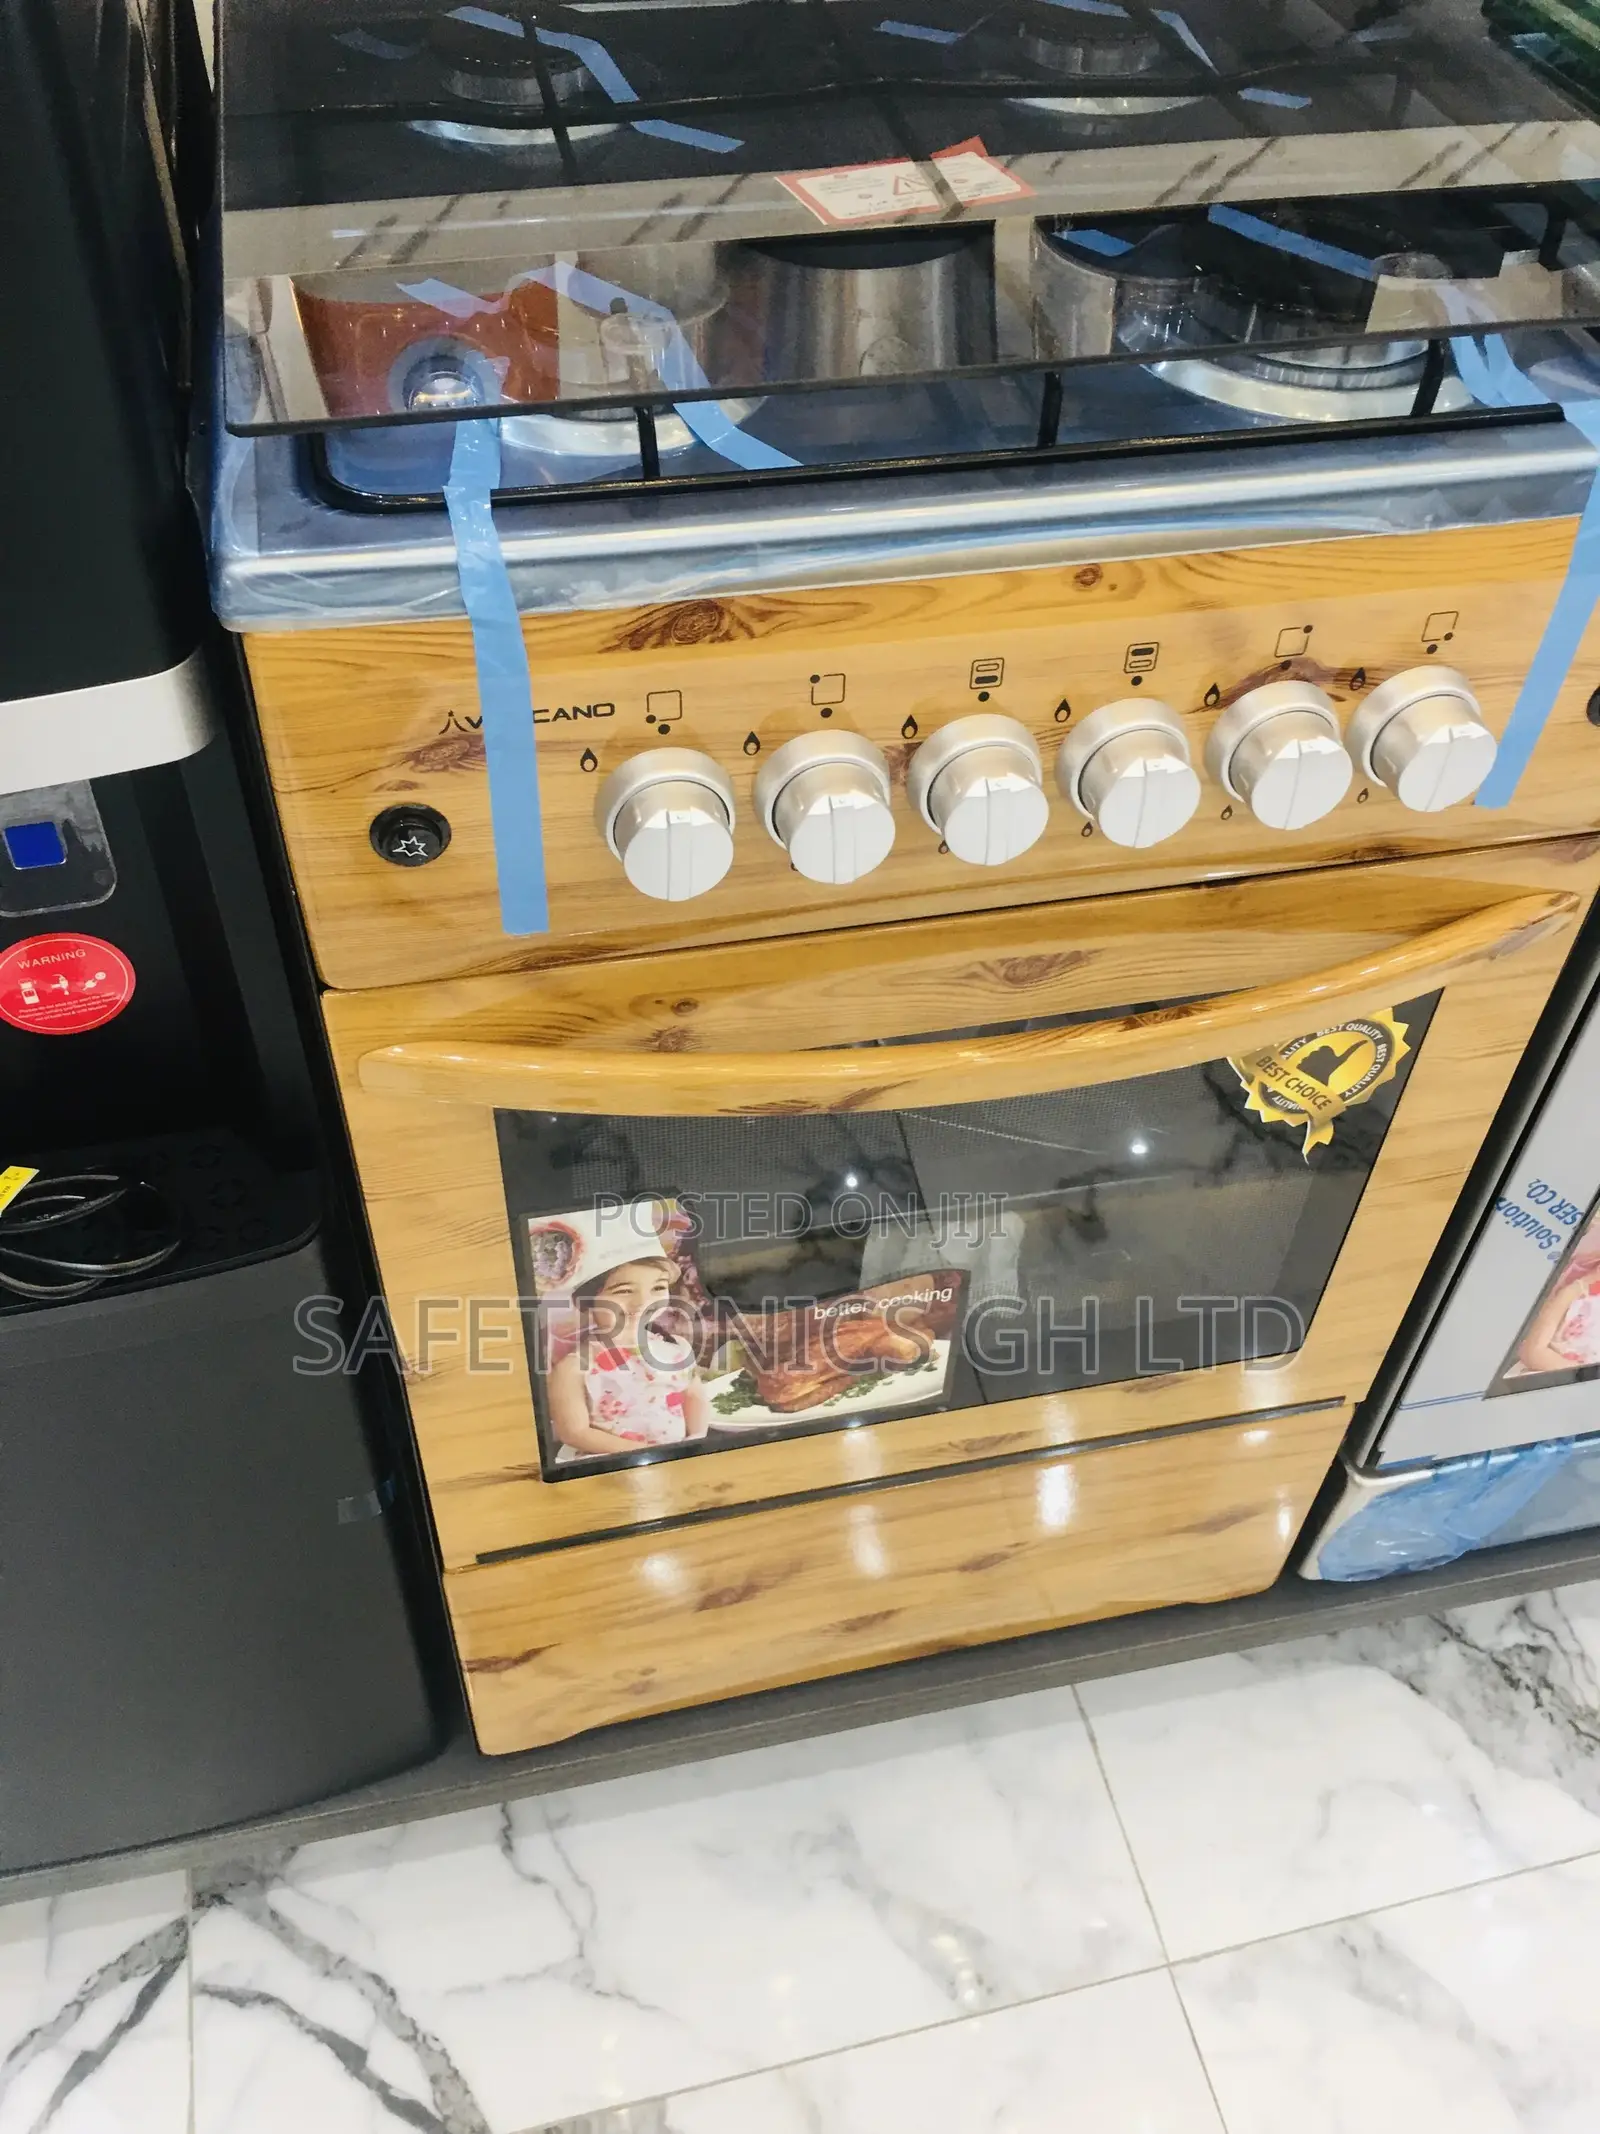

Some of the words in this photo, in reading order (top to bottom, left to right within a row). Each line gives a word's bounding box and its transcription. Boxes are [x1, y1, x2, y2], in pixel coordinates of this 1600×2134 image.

[464, 702, 616, 729] VCANO
[16, 948, 87, 970] WARNING
[1316, 1023, 1345, 1038] BEST
[1345, 1022, 1384, 1041] QUALITY
[1376, 1043, 1388, 1064] BEST
[1256, 1055, 1290, 1082] BEST
[1284, 1077, 1333, 1111] CHOICE
[1344, 1063, 1381, 1098] QUALITY
[1495, 1196, 1562, 1250] Solution
[814, 1299, 869, 1321] better
[877, 1286, 954, 1311] cooking
